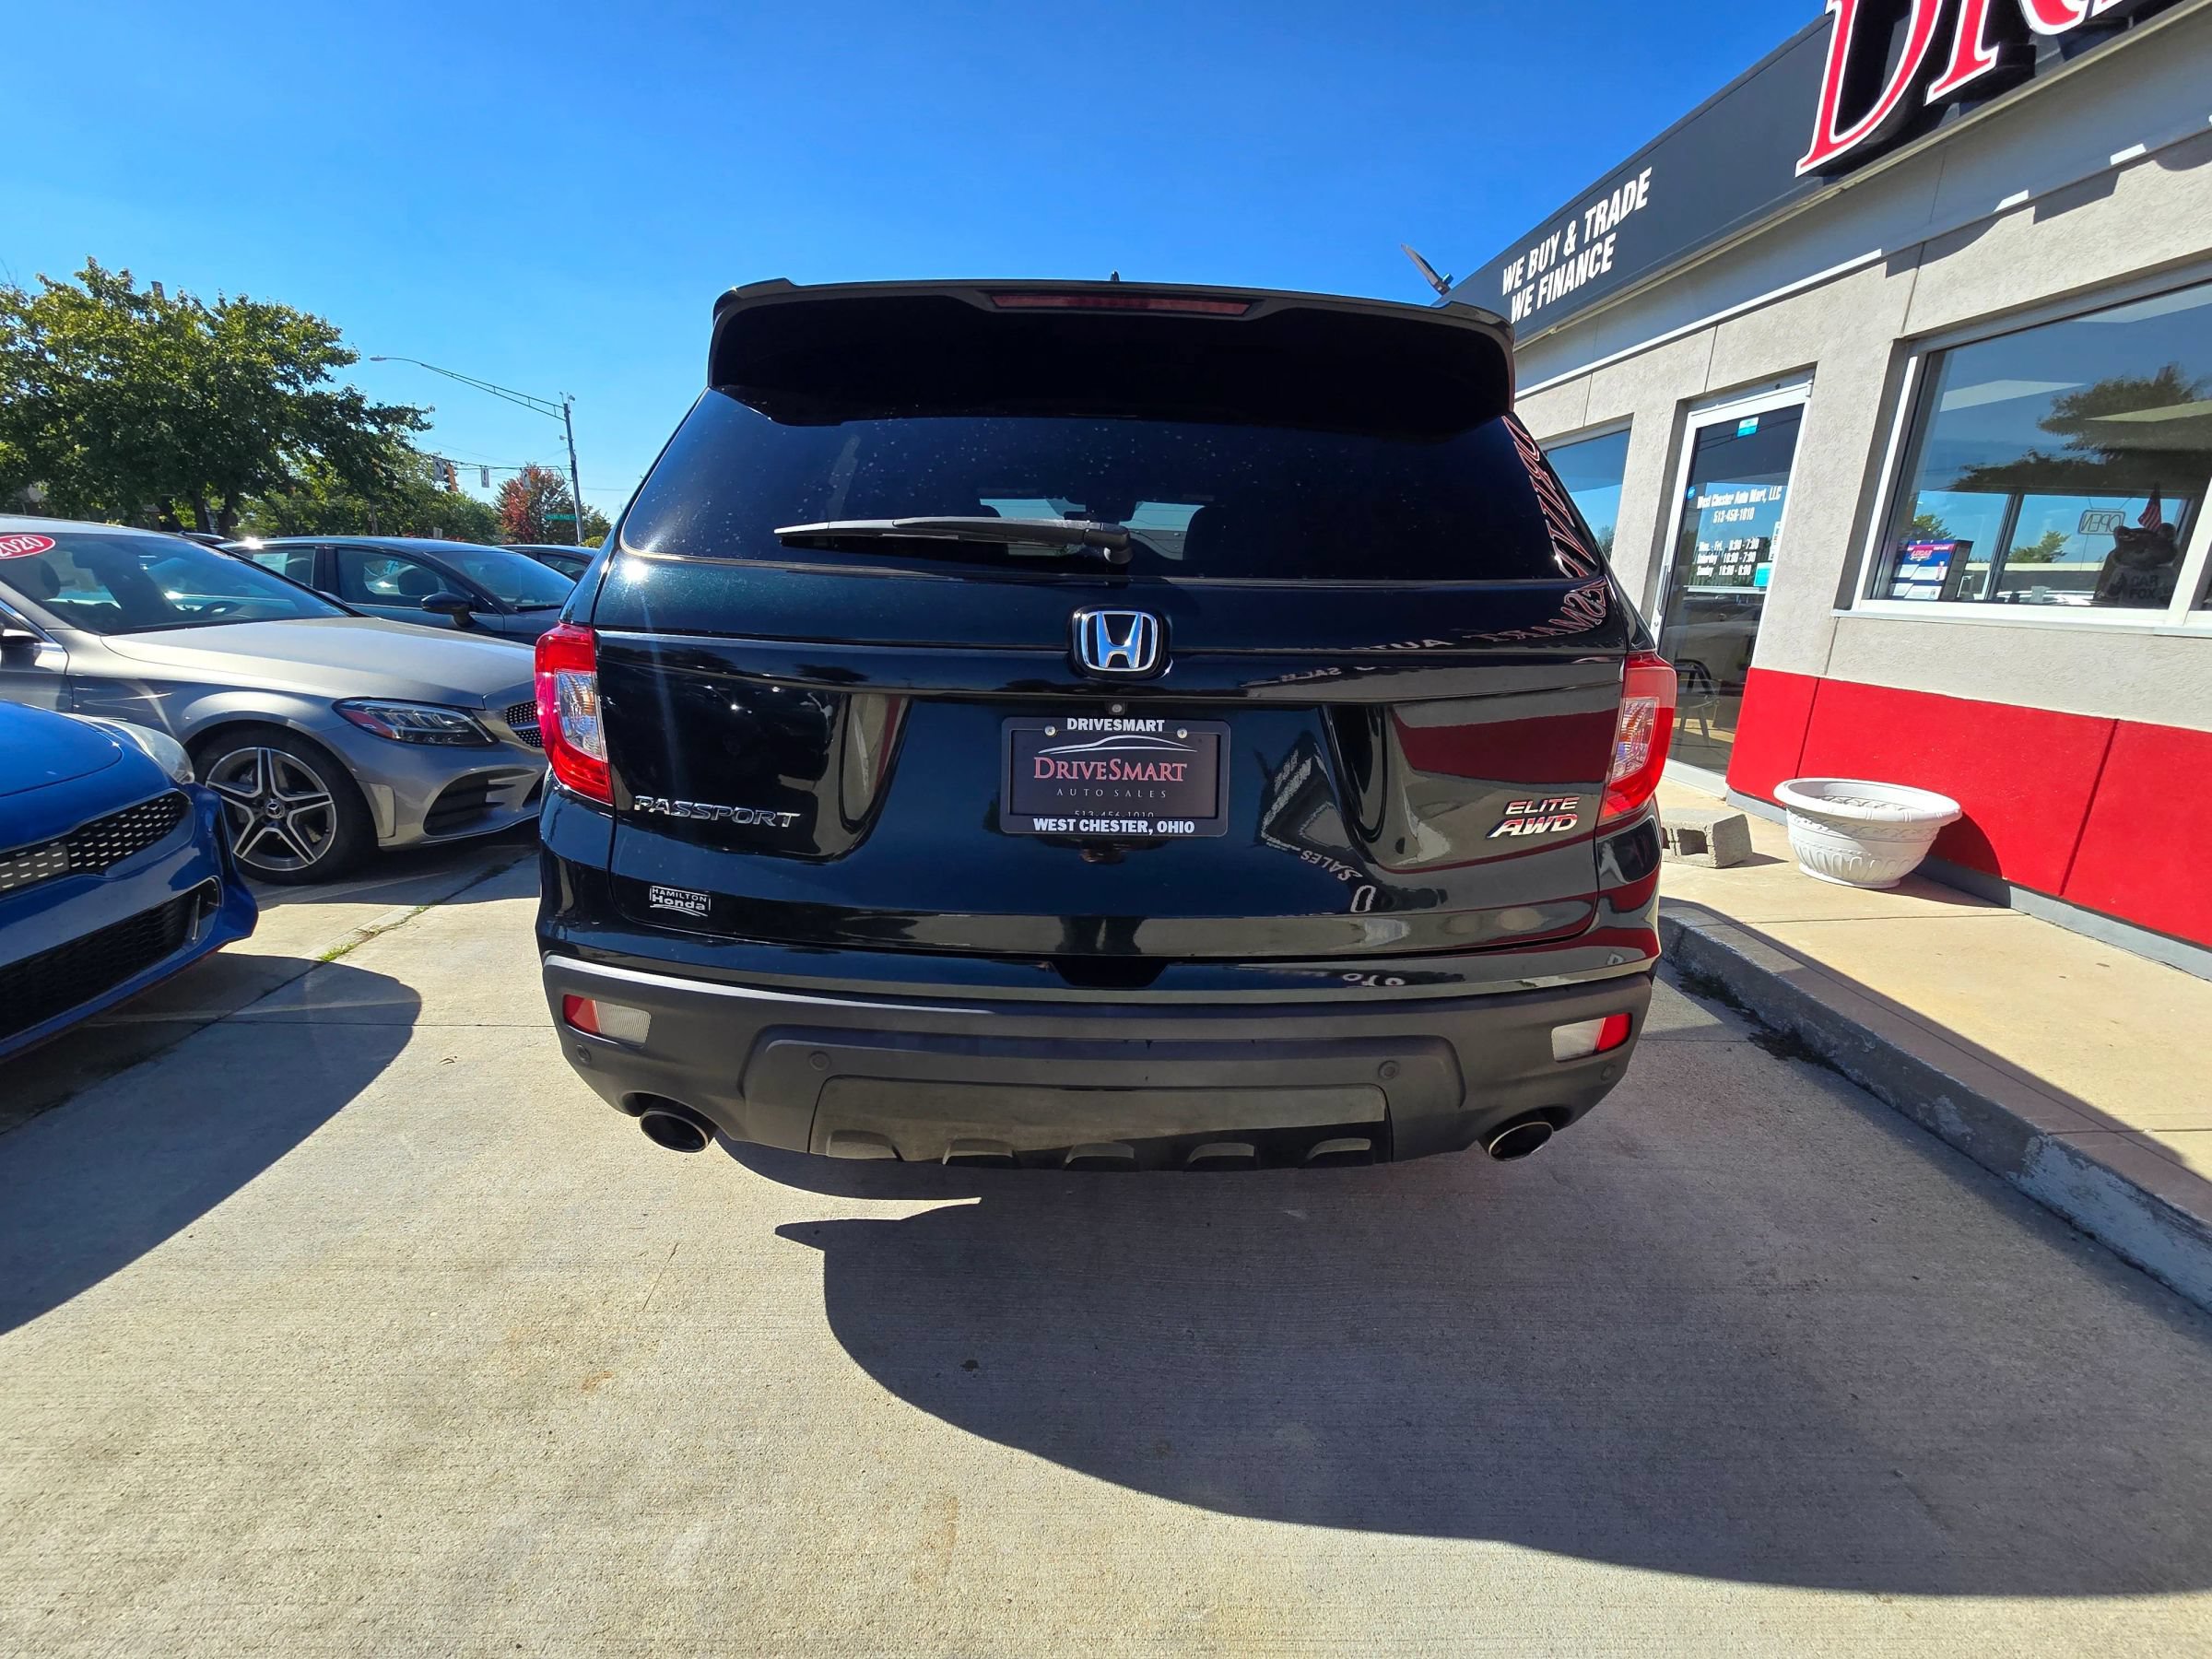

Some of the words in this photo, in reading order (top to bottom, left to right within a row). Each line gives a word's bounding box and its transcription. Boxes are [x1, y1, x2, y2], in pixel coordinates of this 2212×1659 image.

[1502, 254, 1525, 296] WE
[1526, 229, 1561, 280] BUY
[1563, 219, 1577, 256] &
[1584, 167, 1653, 244] TRADE
[1511, 283, 1535, 324] WE
[1536, 232, 1617, 310] FINANCE
[1697, 495, 1712, 509] West
[1734, 490, 1749, 505] Auto
[1769, 486, 1783, 500] LLC
[1066, 717, 1165, 733] DRIVESMART
[1056, 788, 1104, 797] AUTO
[1113, 789, 1167, 798] SALES
[633, 794, 801, 828] PASSPORT
[1505, 796, 1581, 816] ELITE
[1033, 818, 1077, 832] WEST
[1078, 818, 1154, 835] CHESTER,
[1157, 820, 1195, 834] OHIO
[1486, 813, 1578, 839] AWD
[653, 888, 707, 902] HAMILTON
[653, 894, 706, 911] Honda
